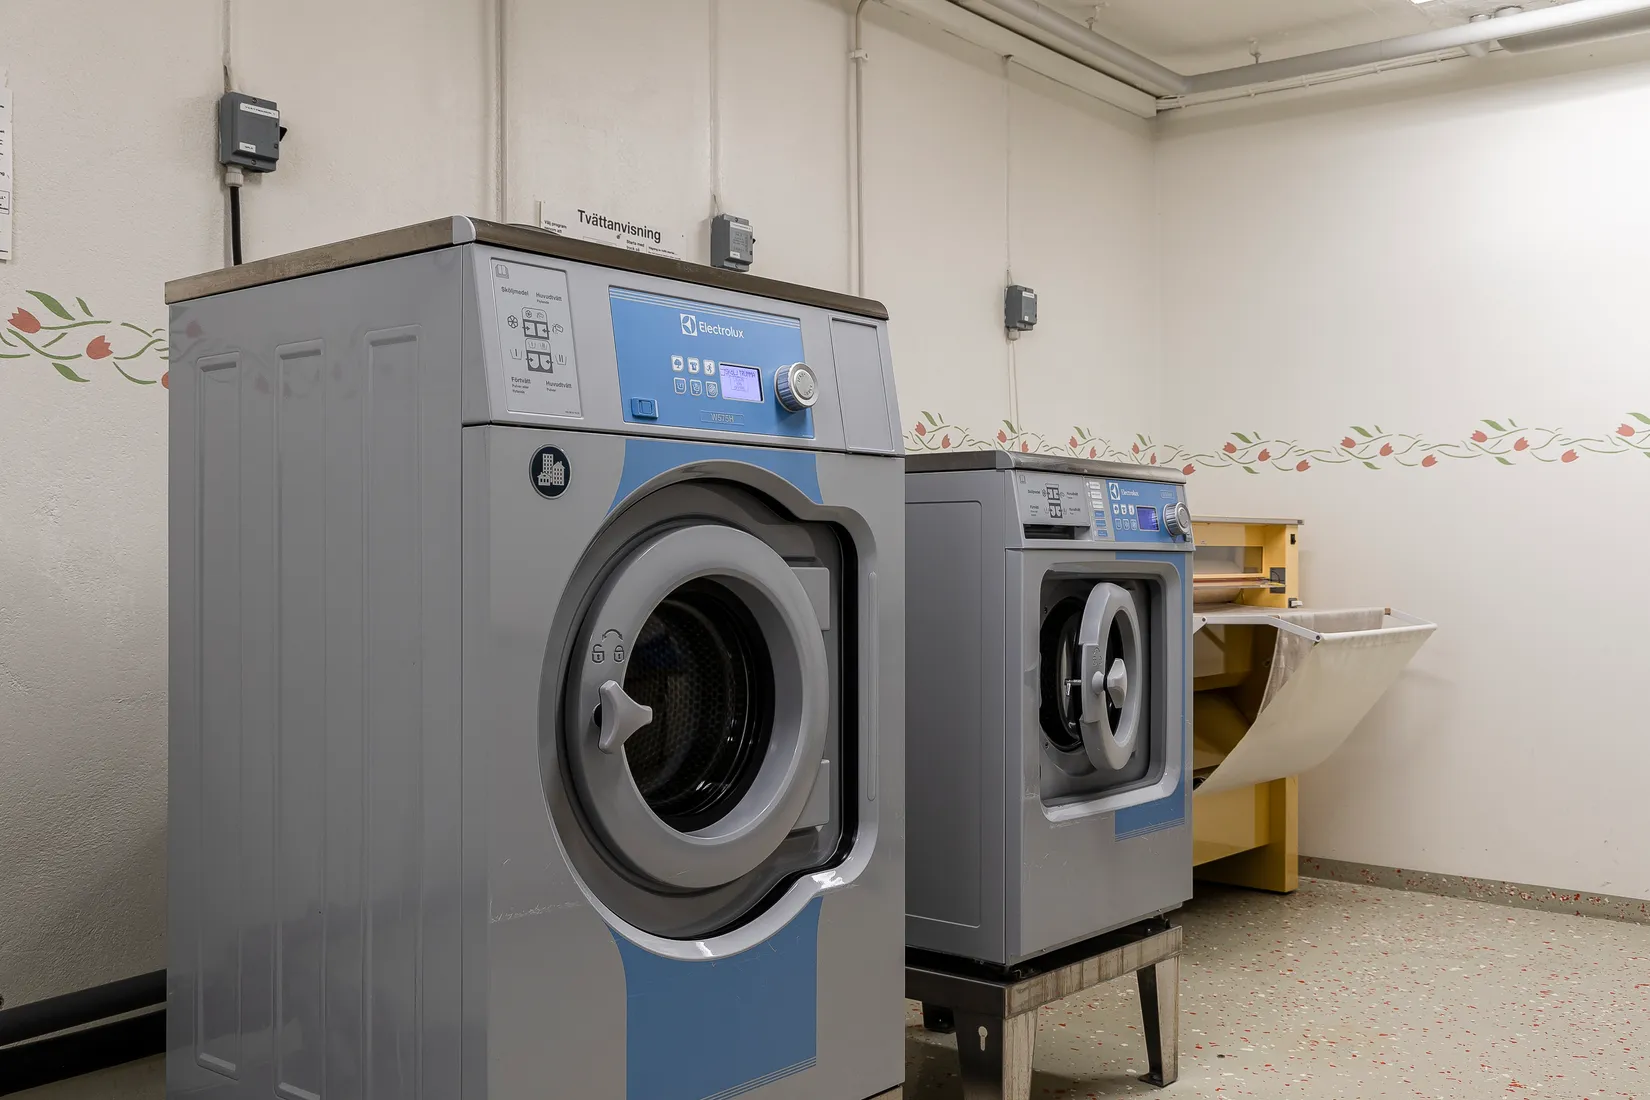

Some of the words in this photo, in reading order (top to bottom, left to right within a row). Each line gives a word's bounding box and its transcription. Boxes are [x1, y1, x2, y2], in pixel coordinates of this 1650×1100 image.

[577, 209, 661, 244] Tvättanvisning
[501, 286, 529, 296] Sköljmedel
[536, 292, 562, 301] Huvudtvätt
[699, 321, 745, 339] Electrolux
[511, 376, 531, 384] Förtvätt
[545, 380, 573, 388] Huvudtvätt
[711, 413, 734, 423] W575H
